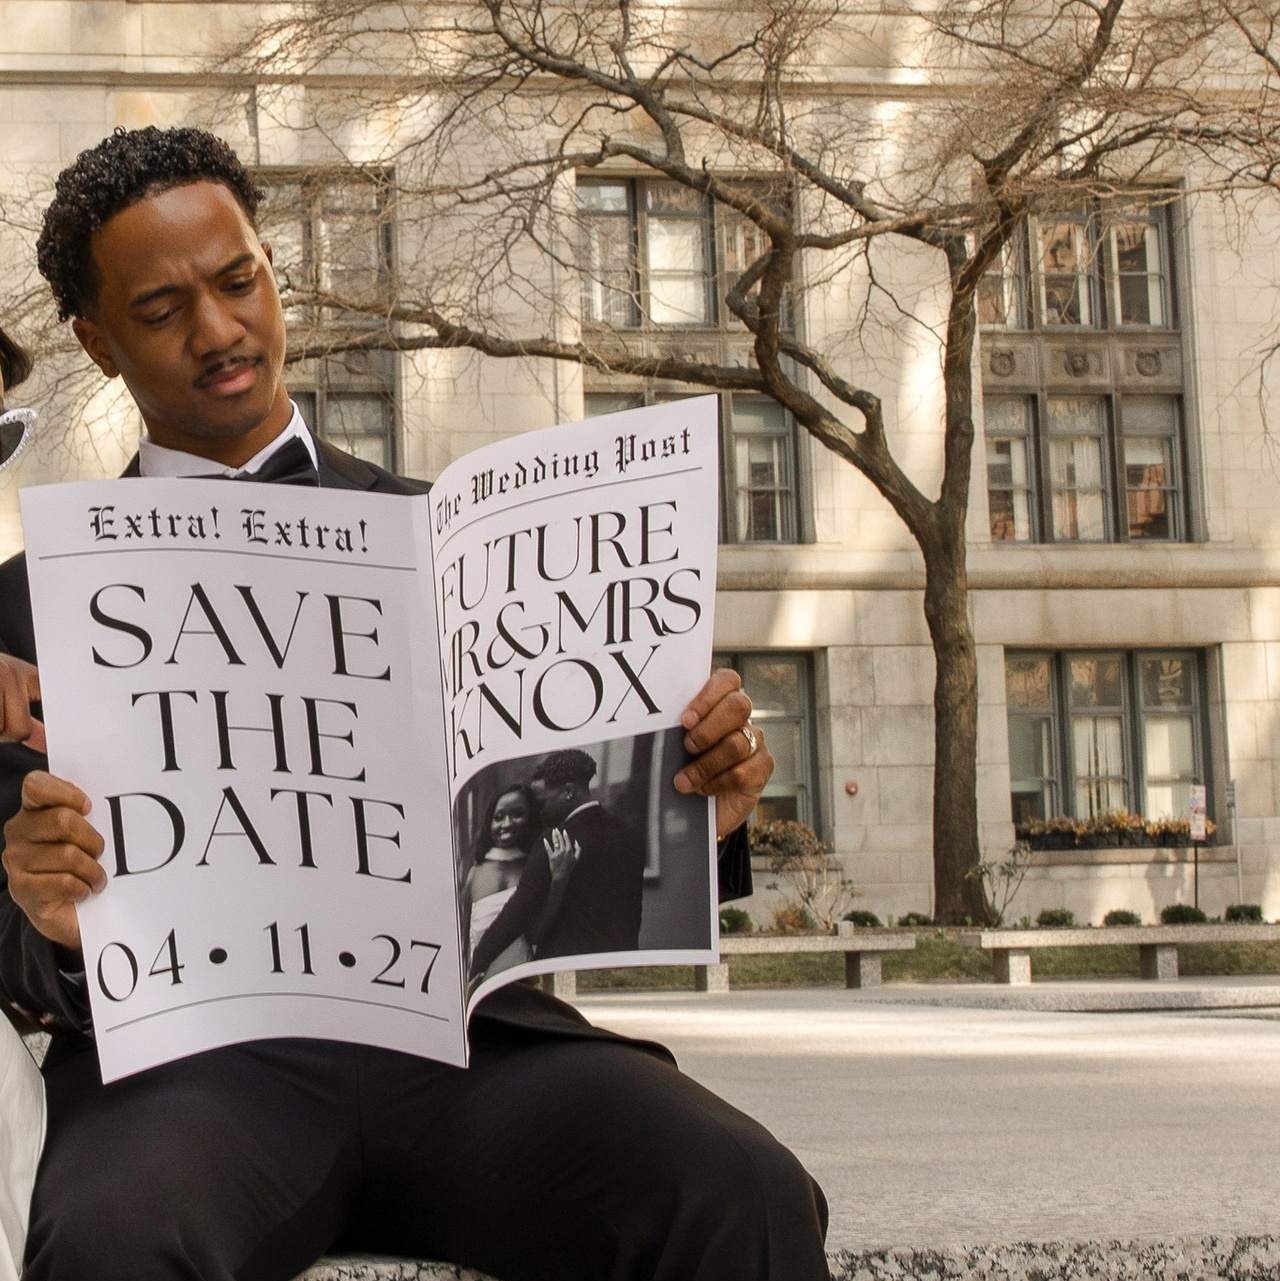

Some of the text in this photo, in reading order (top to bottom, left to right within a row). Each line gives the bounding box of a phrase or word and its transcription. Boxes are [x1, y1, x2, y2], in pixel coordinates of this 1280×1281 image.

[87, 505, 369, 553] Extra! Extra!
[436, 426, 692, 536] The Wedding Post
[440, 500, 680, 637] FUTURE
[89, 581, 392, 682] SAVE
[131, 689, 367, 783] THE
[450, 643, 663, 782] KNOX
[104, 785, 413, 885] DATE
